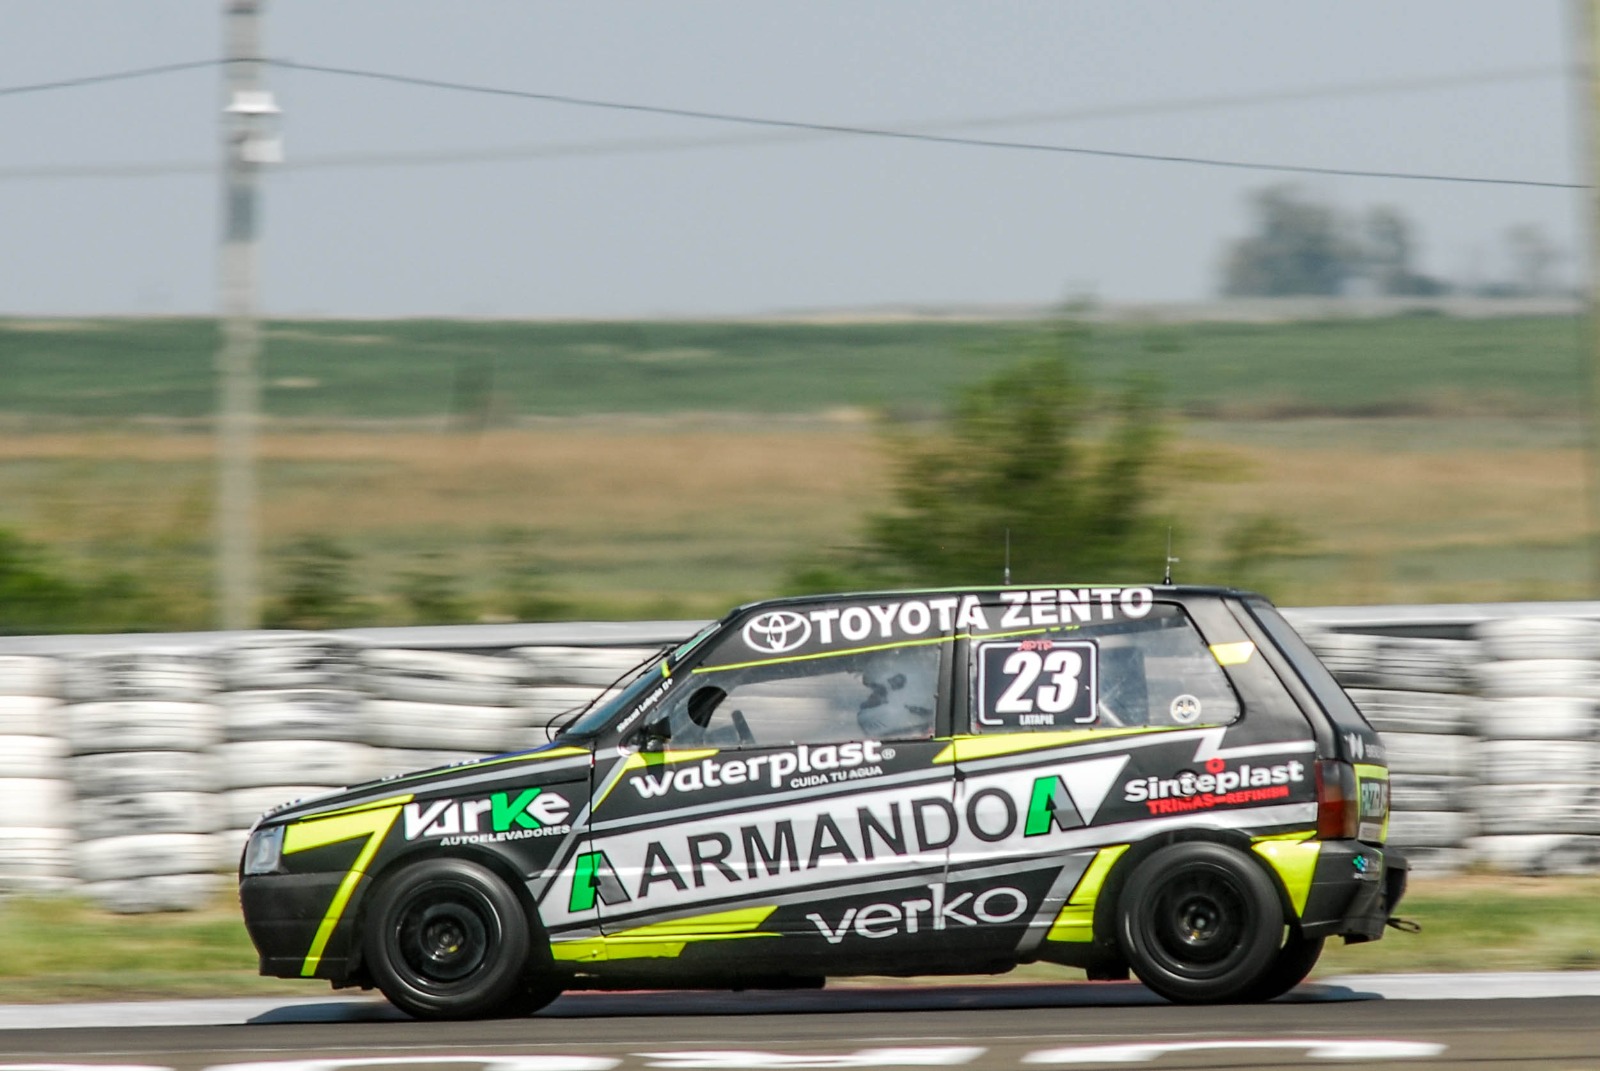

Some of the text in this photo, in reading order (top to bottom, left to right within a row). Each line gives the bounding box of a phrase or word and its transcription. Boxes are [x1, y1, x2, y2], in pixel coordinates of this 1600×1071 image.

[811, 587, 1153, 644] TOYOTA ZENTO
[995, 650, 1083, 713] 23
[1019, 714, 1055, 726] LATAPIE
[790, 766, 883, 789] CUIDA TU AGUA
[440, 825, 570, 846] AUTOELEVADORES
[636, 786, 1018, 899] ARMANDO
[806, 882, 1028, 944] verko
